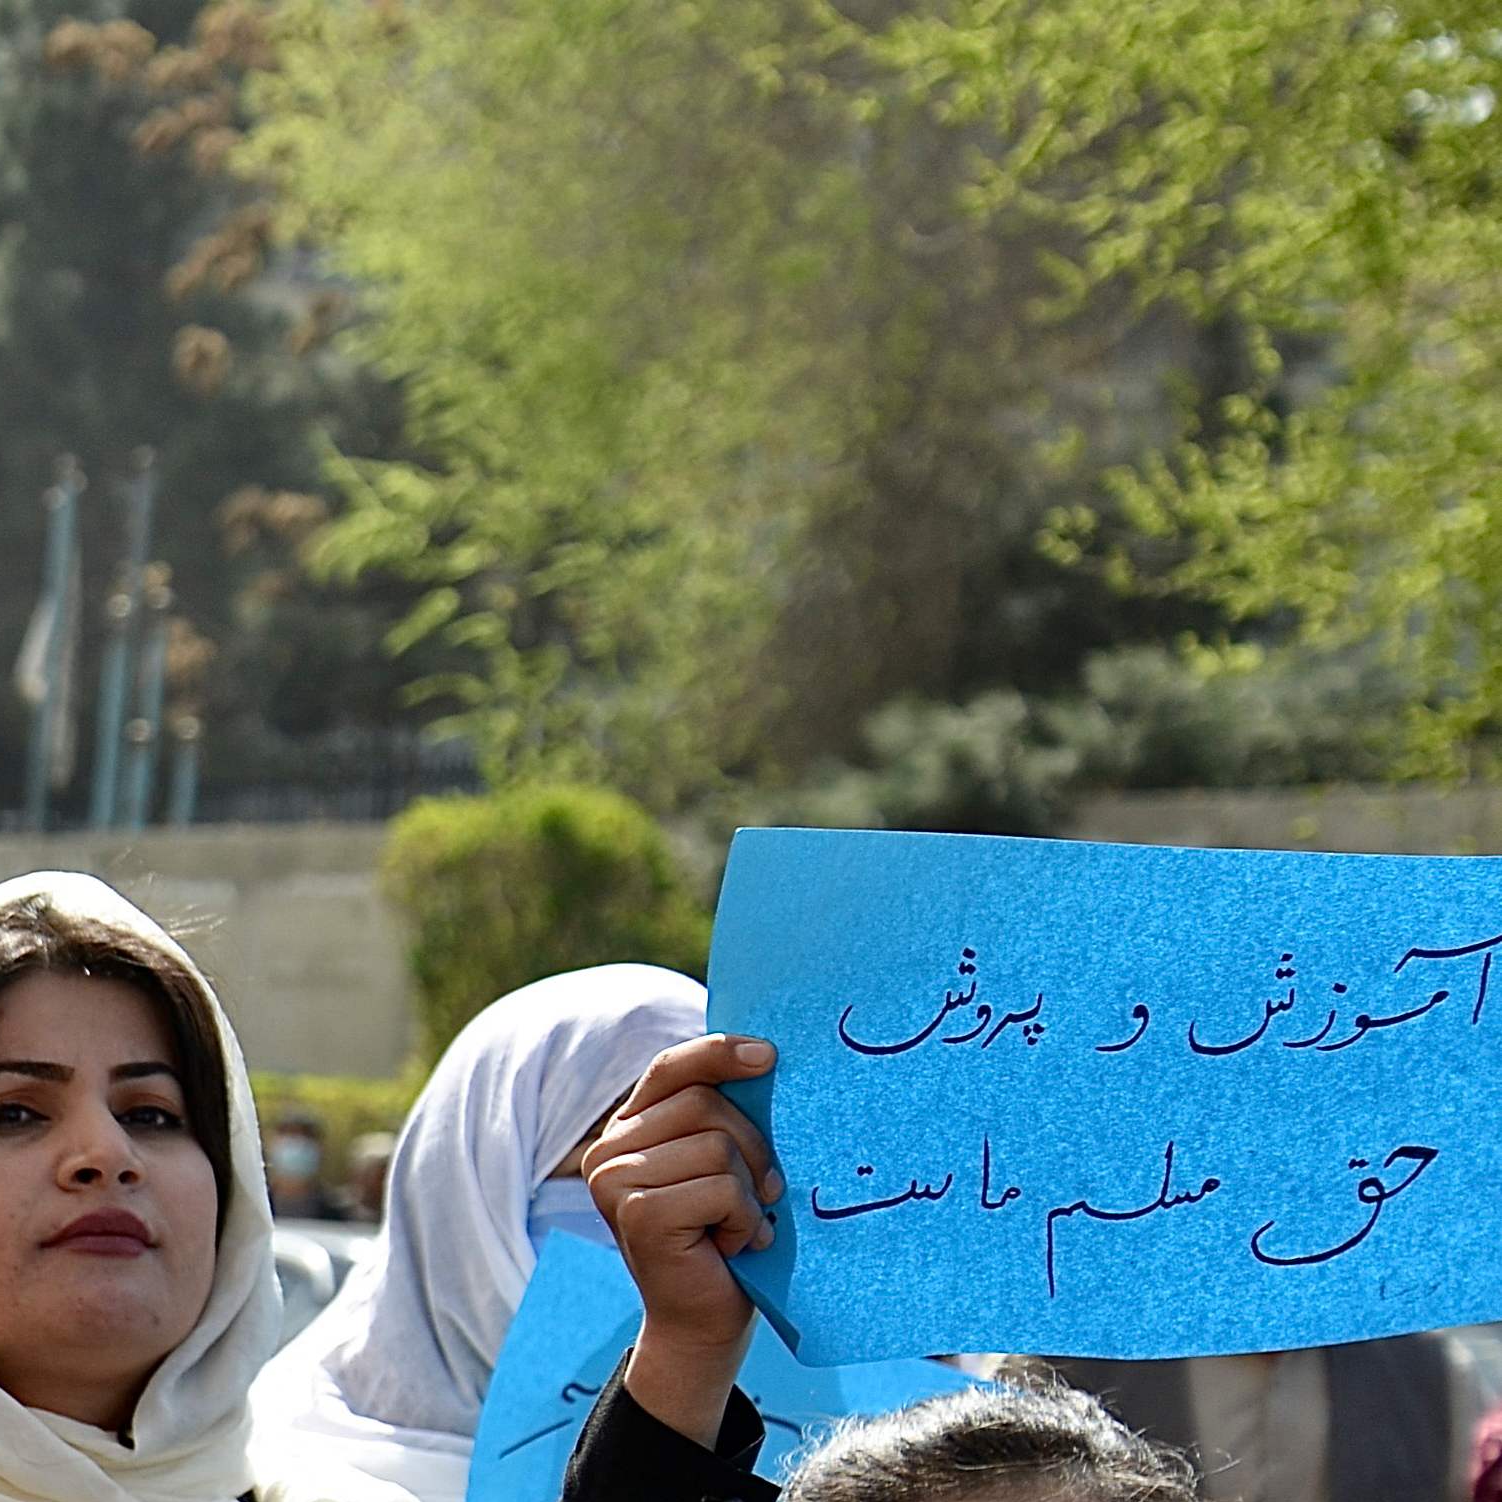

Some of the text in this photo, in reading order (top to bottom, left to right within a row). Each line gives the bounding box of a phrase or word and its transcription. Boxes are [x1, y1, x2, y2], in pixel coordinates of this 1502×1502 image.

[1095, 1005, 1149, 1051] و
[1189, 935, 1502, 1055] آموزش
[1047, 1141, 1220, 1298] مسلم
[1251, 1146, 1439, 1265] حق
